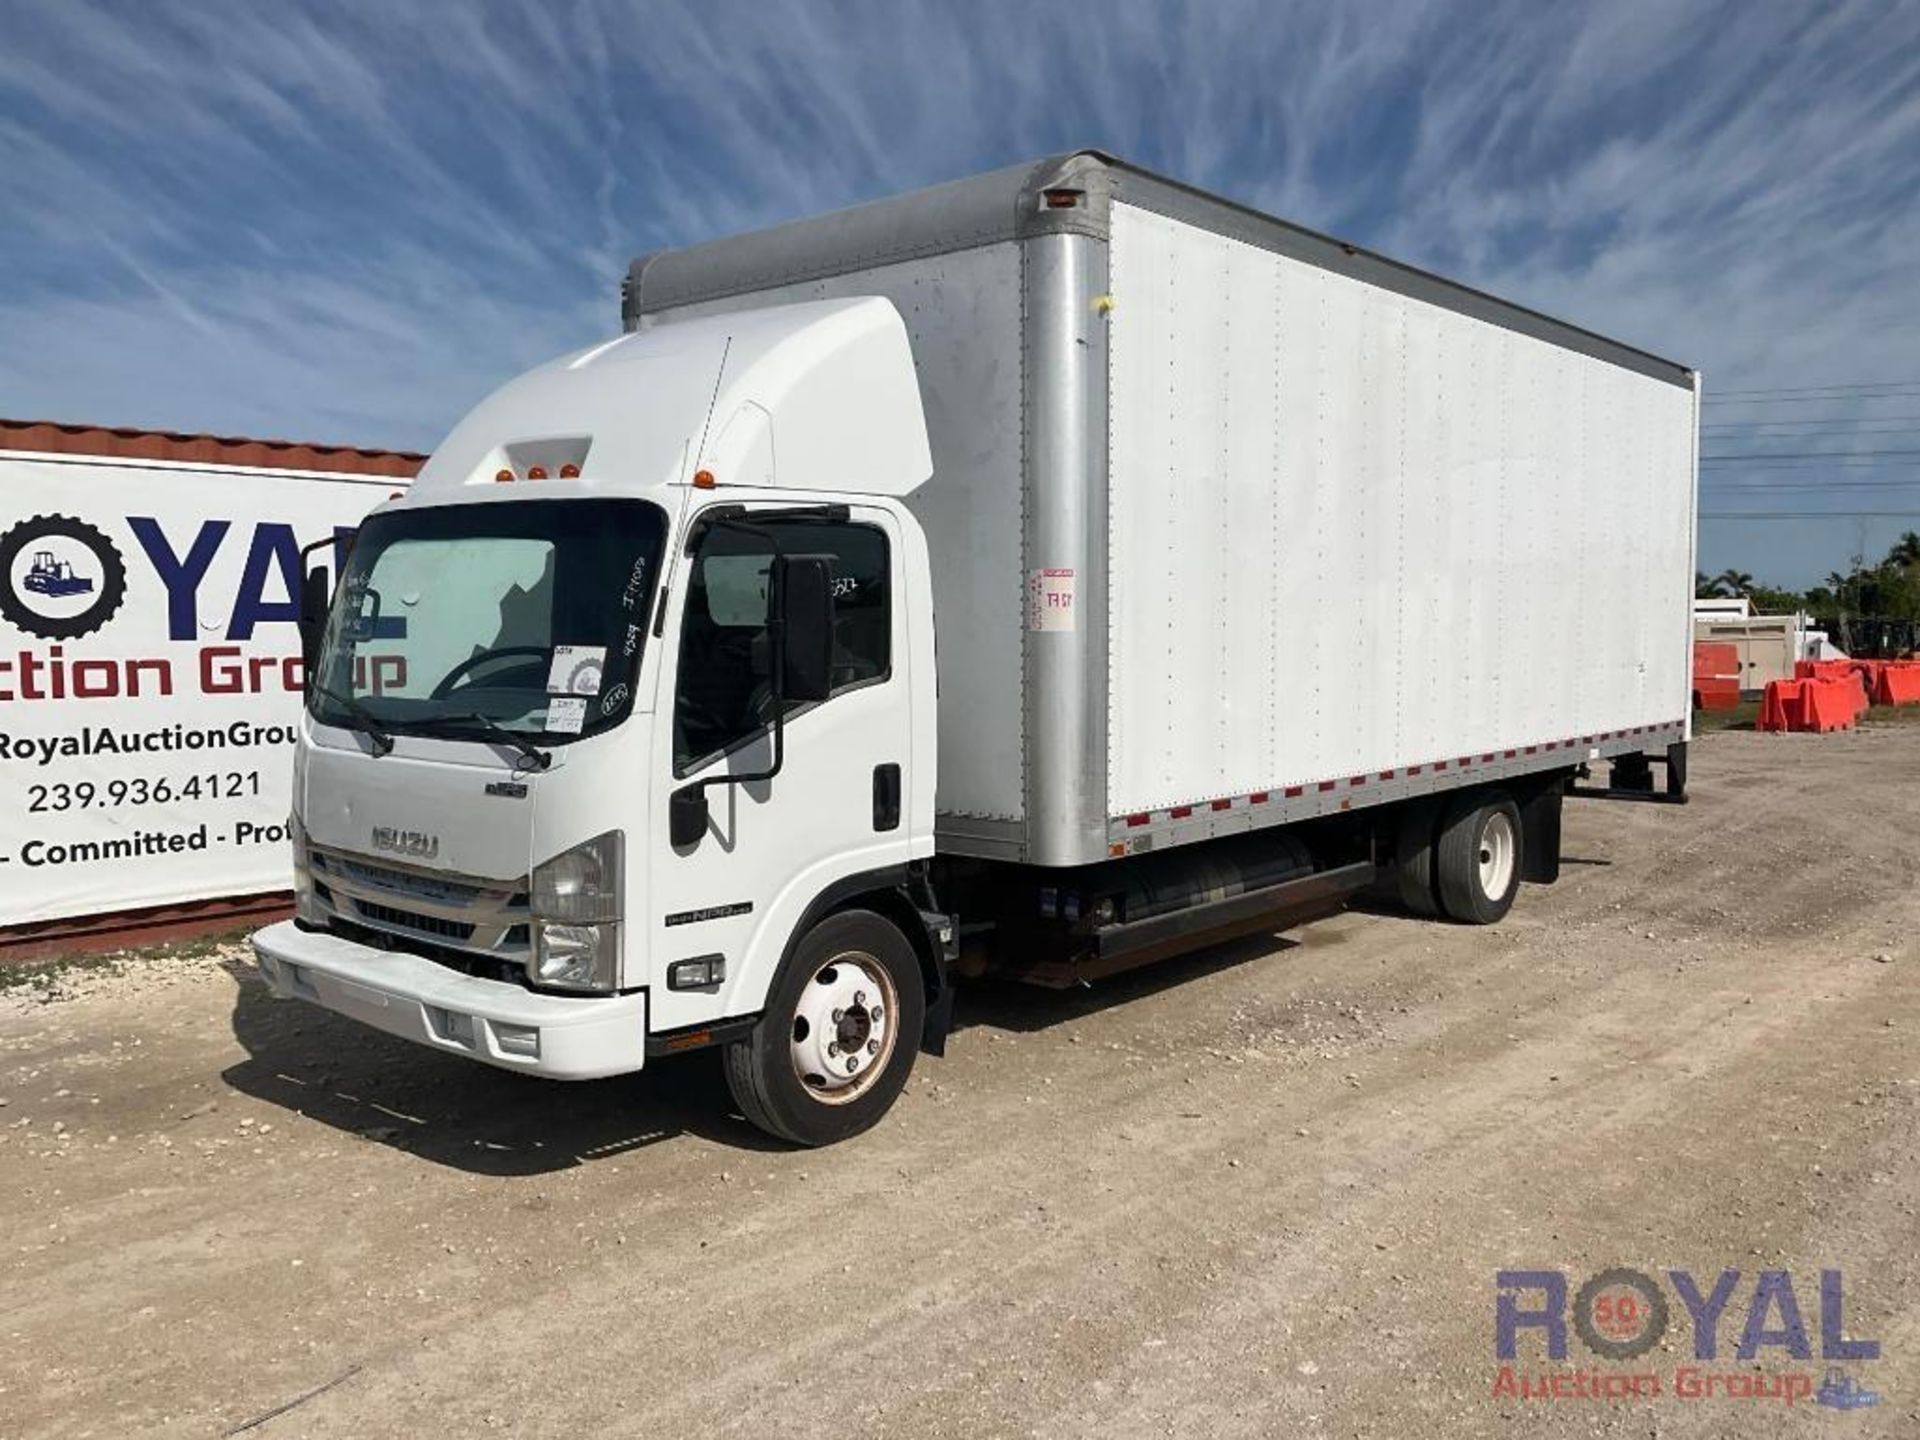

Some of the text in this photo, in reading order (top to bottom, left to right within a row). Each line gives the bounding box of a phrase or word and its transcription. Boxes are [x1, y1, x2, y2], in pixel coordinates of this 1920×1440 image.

[27, 771, 261, 813] 239.936.4121
[20, 820, 207, 867] Committed
[371, 825, 440, 860] ISUZU
